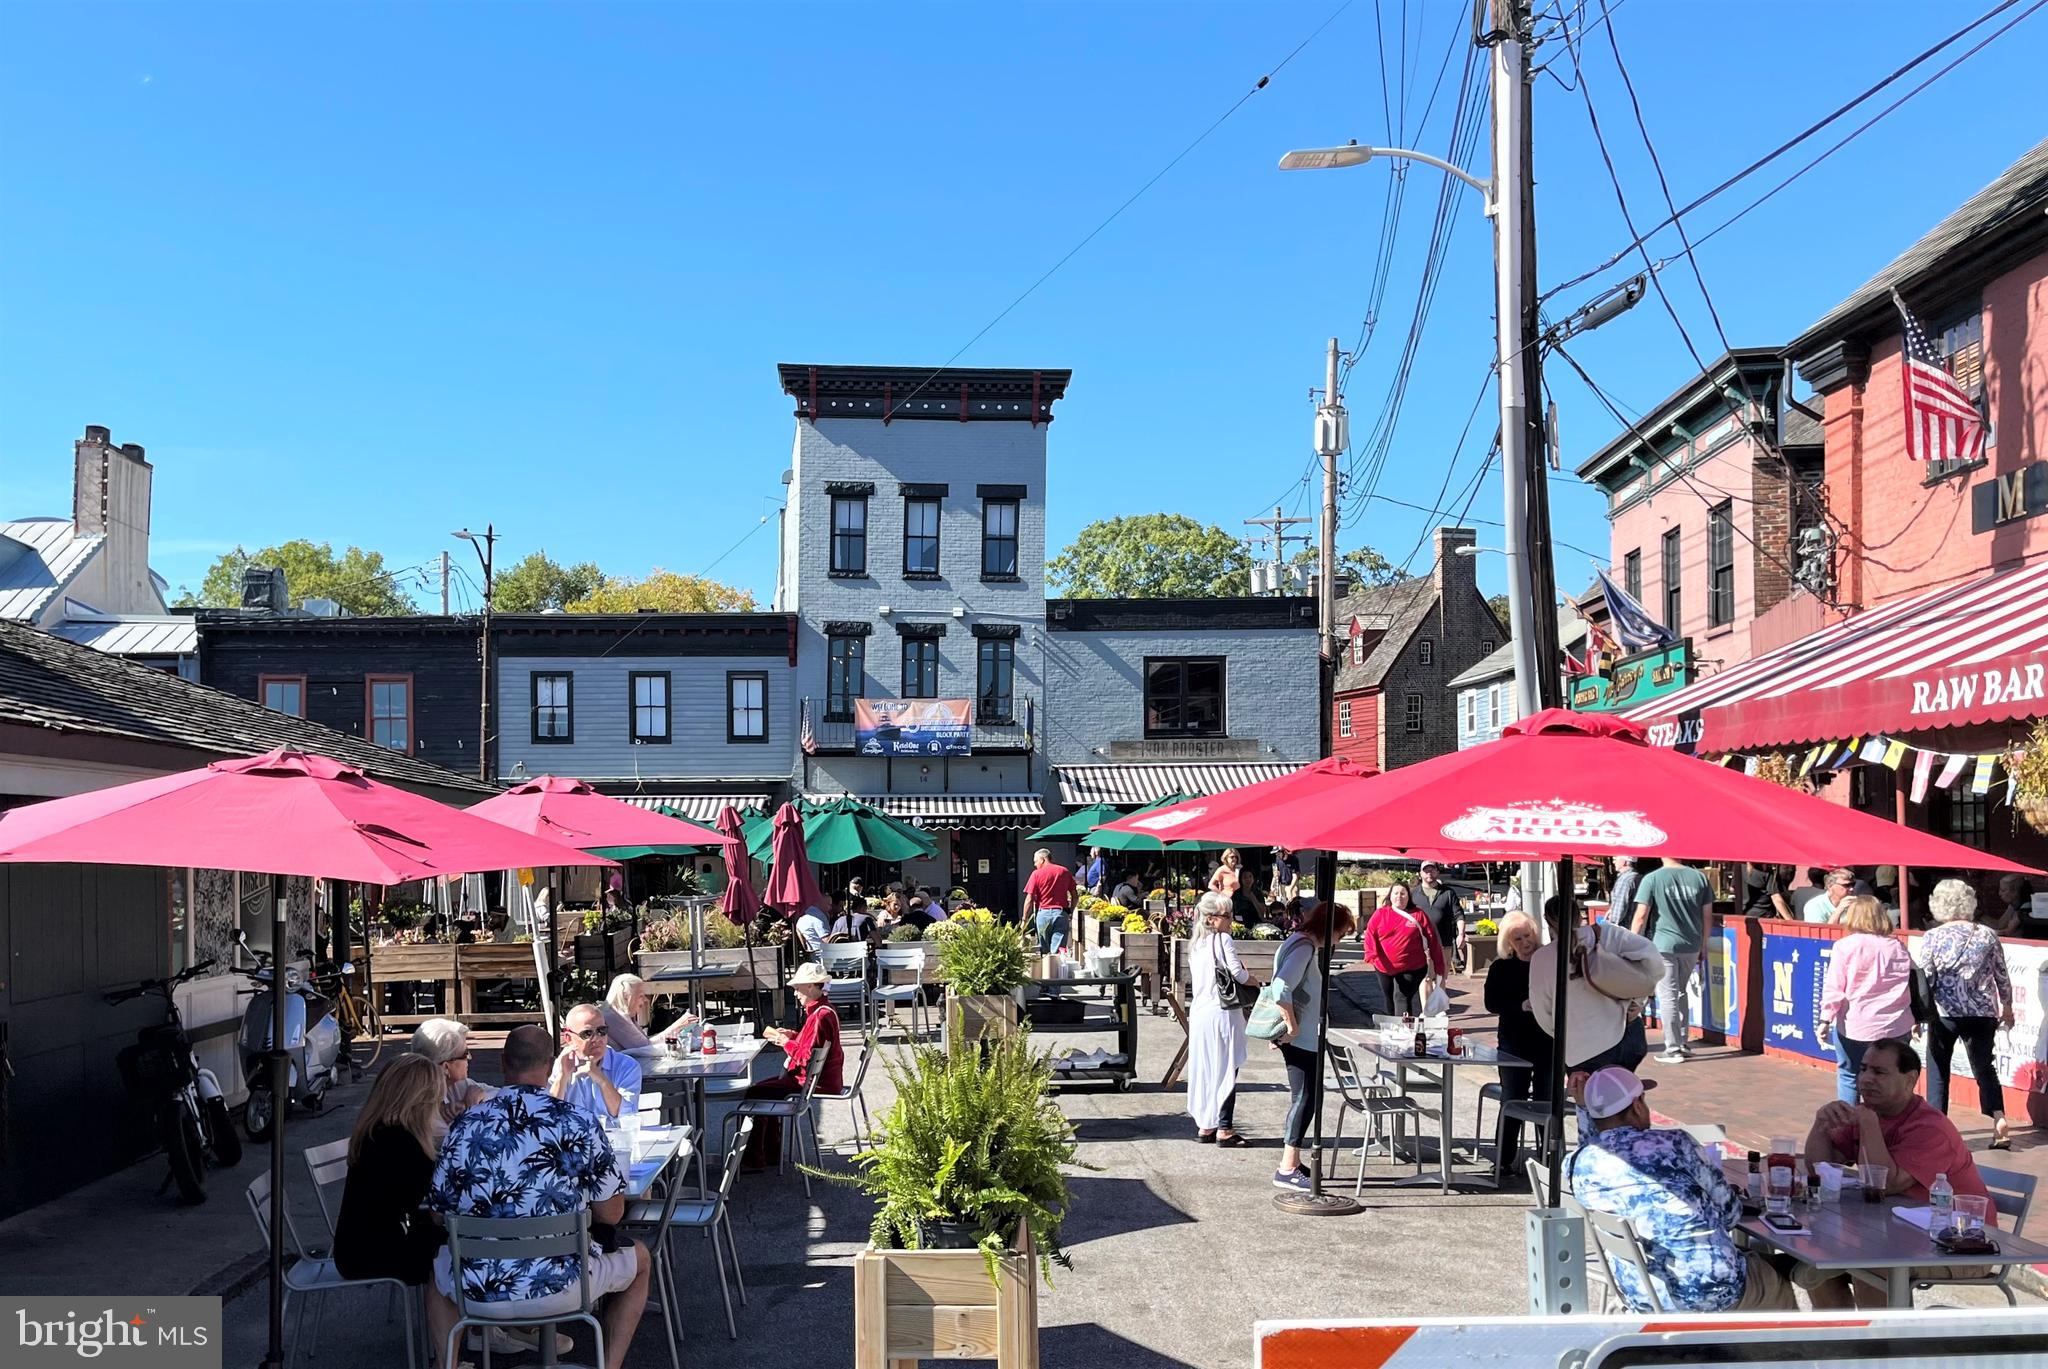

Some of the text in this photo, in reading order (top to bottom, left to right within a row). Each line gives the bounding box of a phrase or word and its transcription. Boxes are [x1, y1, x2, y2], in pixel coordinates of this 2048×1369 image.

[1910, 663, 2045, 714] RAW BAR
[1648, 719, 1705, 747] STEAKS
[1172, 741, 1224, 757] ROOSTER
[1488, 815, 1621, 828] STELLA
[1484, 826, 1623, 838] ARTOIS
